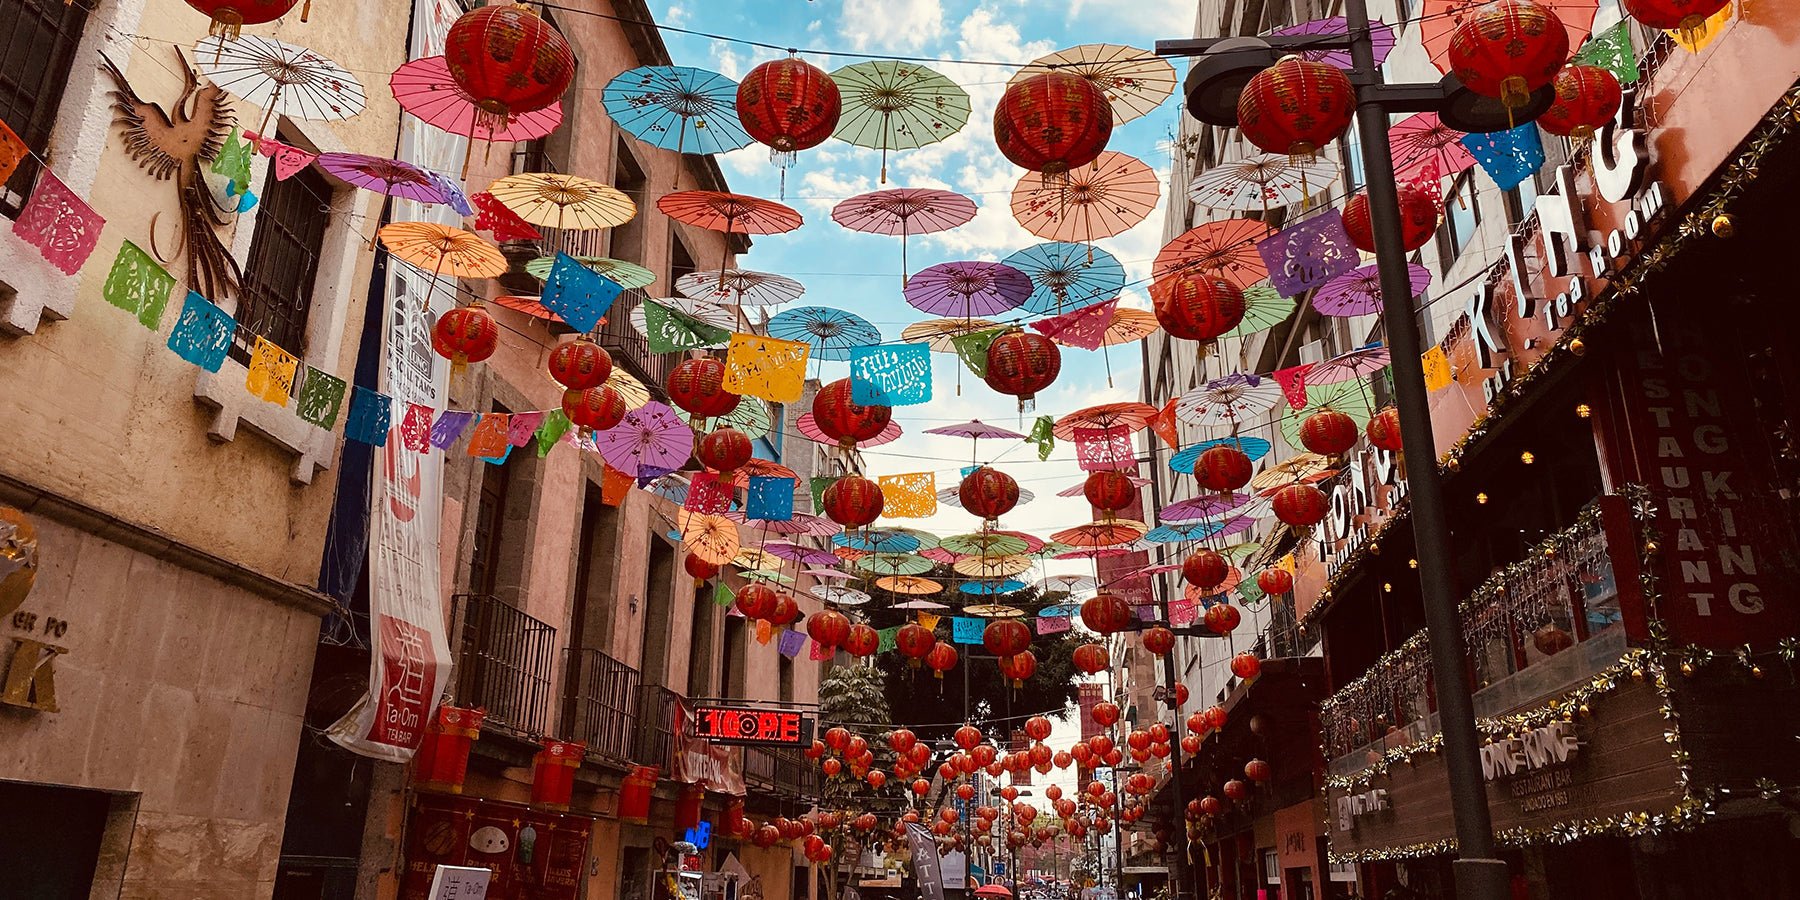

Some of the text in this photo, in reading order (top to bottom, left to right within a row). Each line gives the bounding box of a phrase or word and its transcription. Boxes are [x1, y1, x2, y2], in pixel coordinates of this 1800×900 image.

[1466, 89, 1639, 370] KING
[1481, 181, 1664, 405] Bar Tea Room
[1701, 471, 1766, 615] KING
[1555, 768, 1573, 787] BAR
[912, 831, 937, 900] TATT
